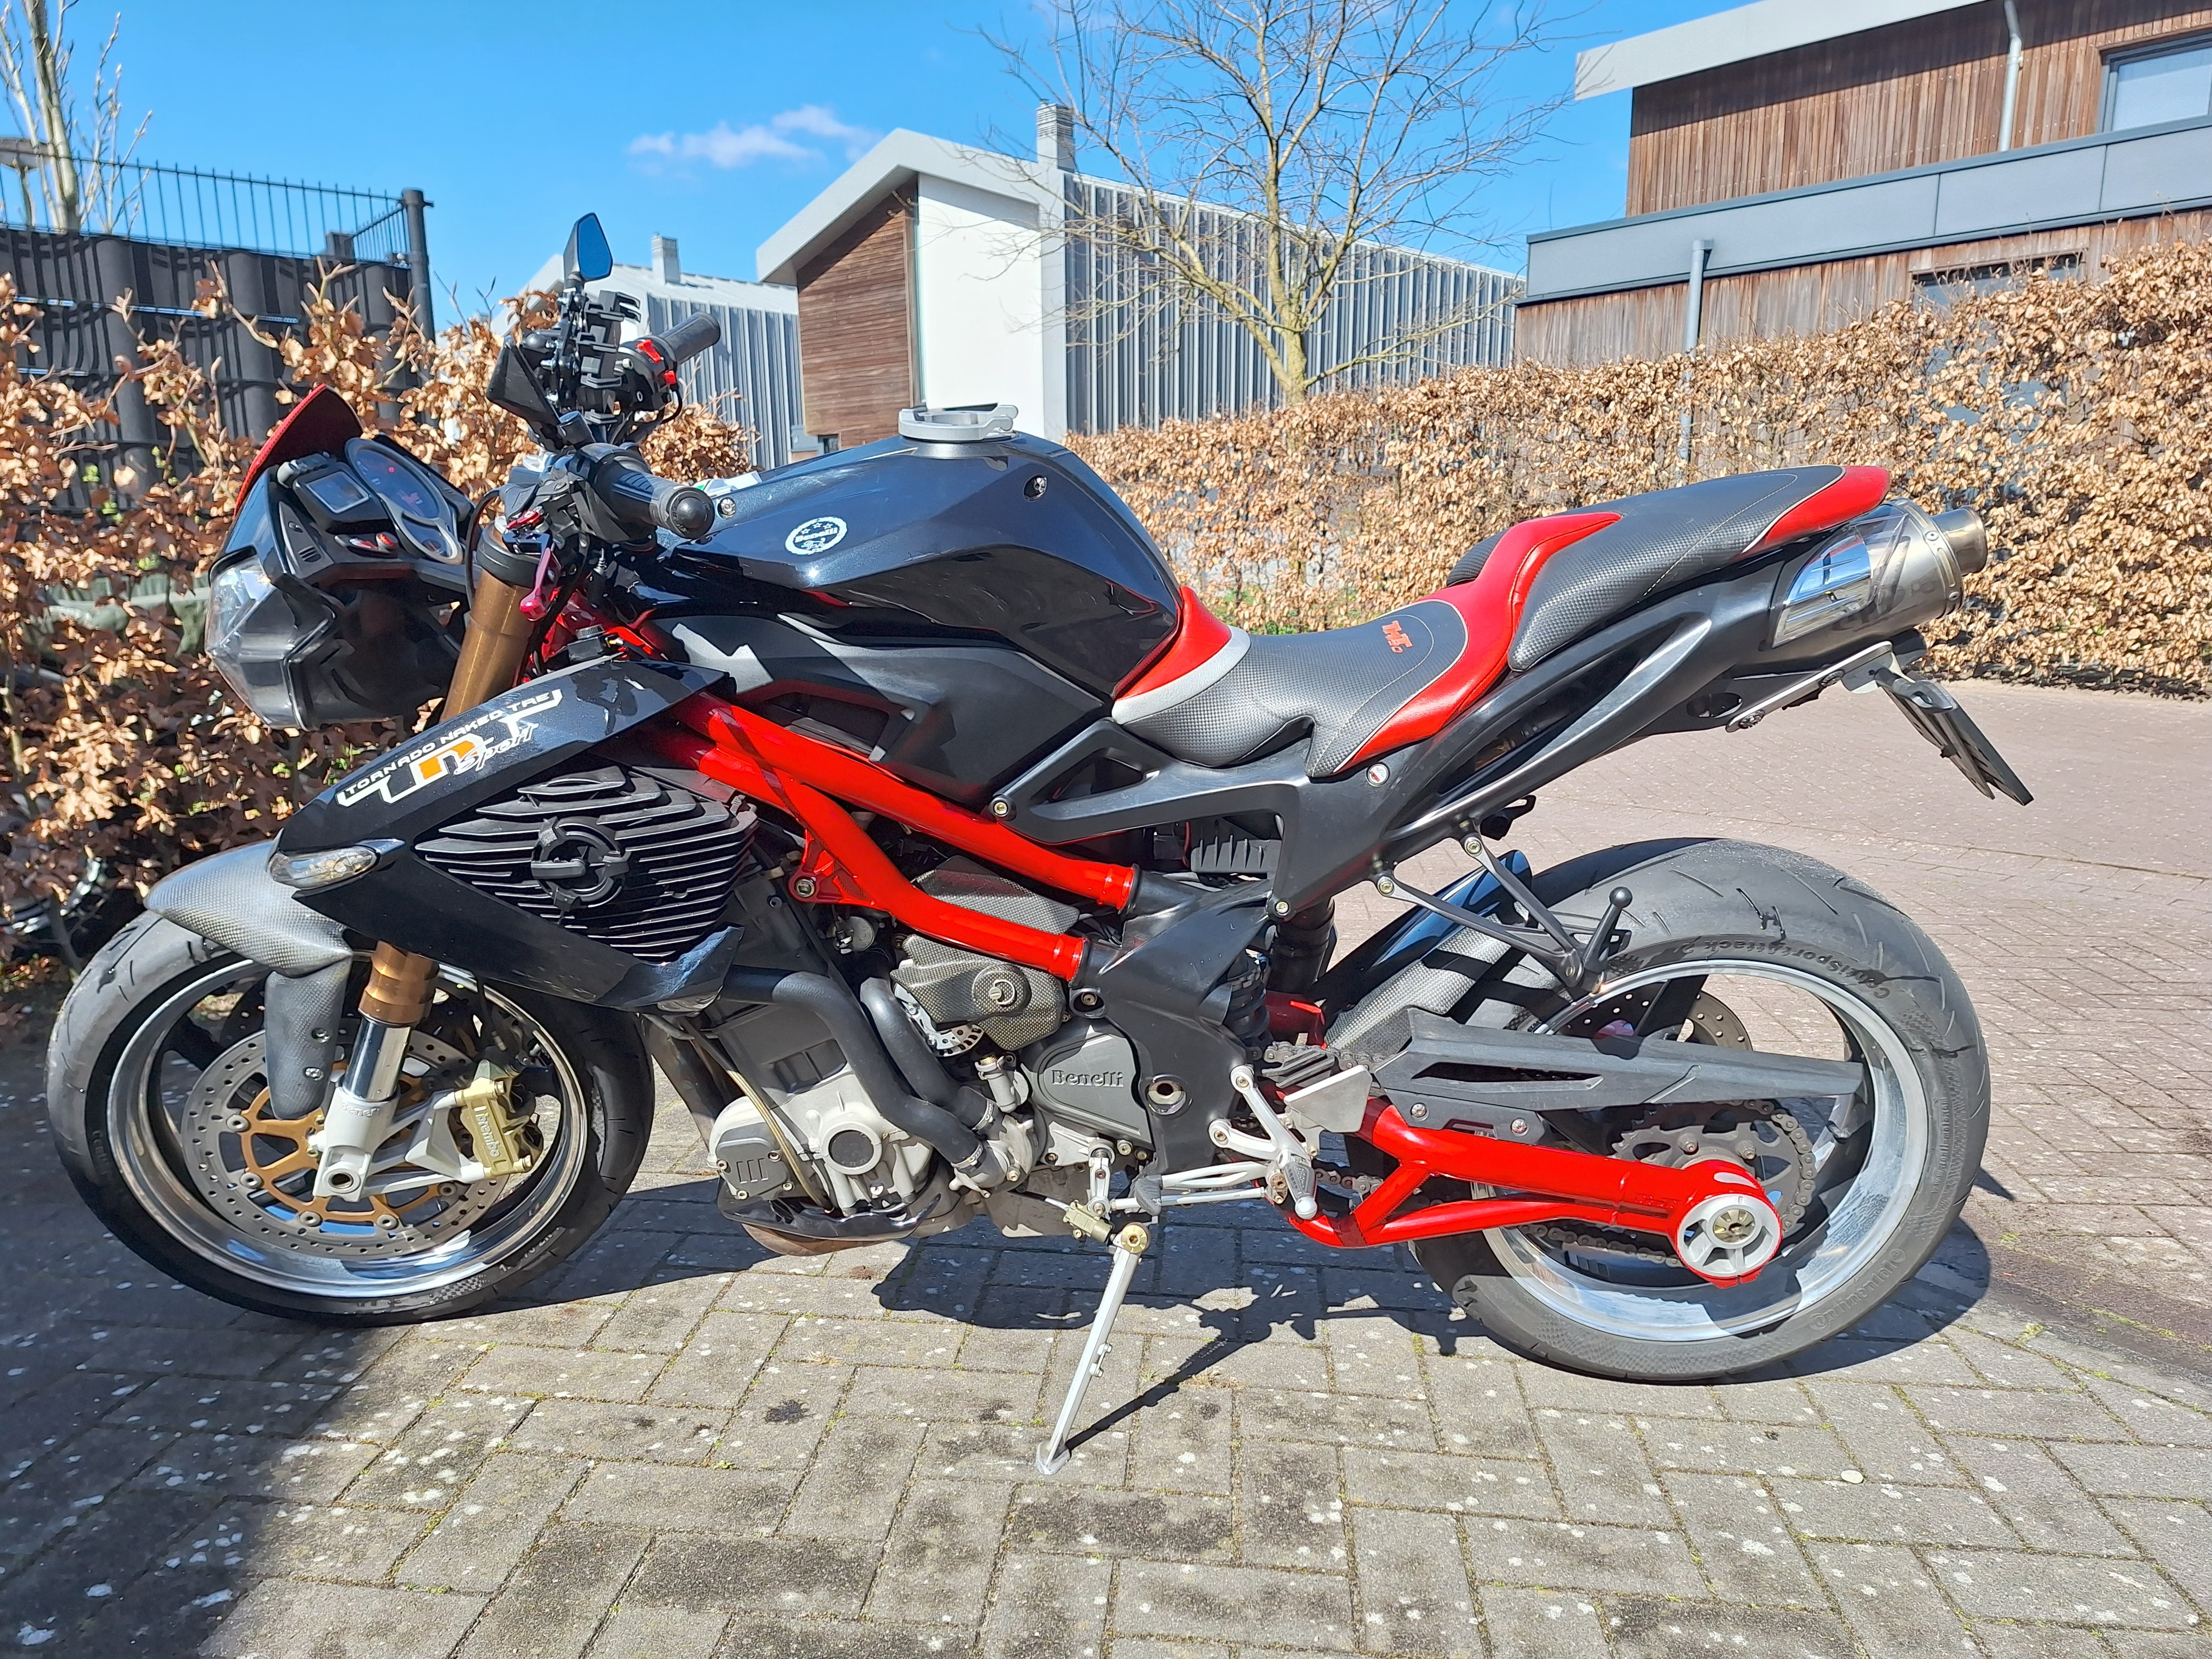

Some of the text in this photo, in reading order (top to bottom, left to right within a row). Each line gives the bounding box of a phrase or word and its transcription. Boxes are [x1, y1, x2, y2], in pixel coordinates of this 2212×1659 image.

[795, 527, 838, 543] Benelli
[346, 692, 550, 795] TORNADO NAKED TRE
[454, 722, 539, 775] Sport
[1051, 1069, 1124, 1088] Benelli
[475, 1113, 500, 1158] brembo
